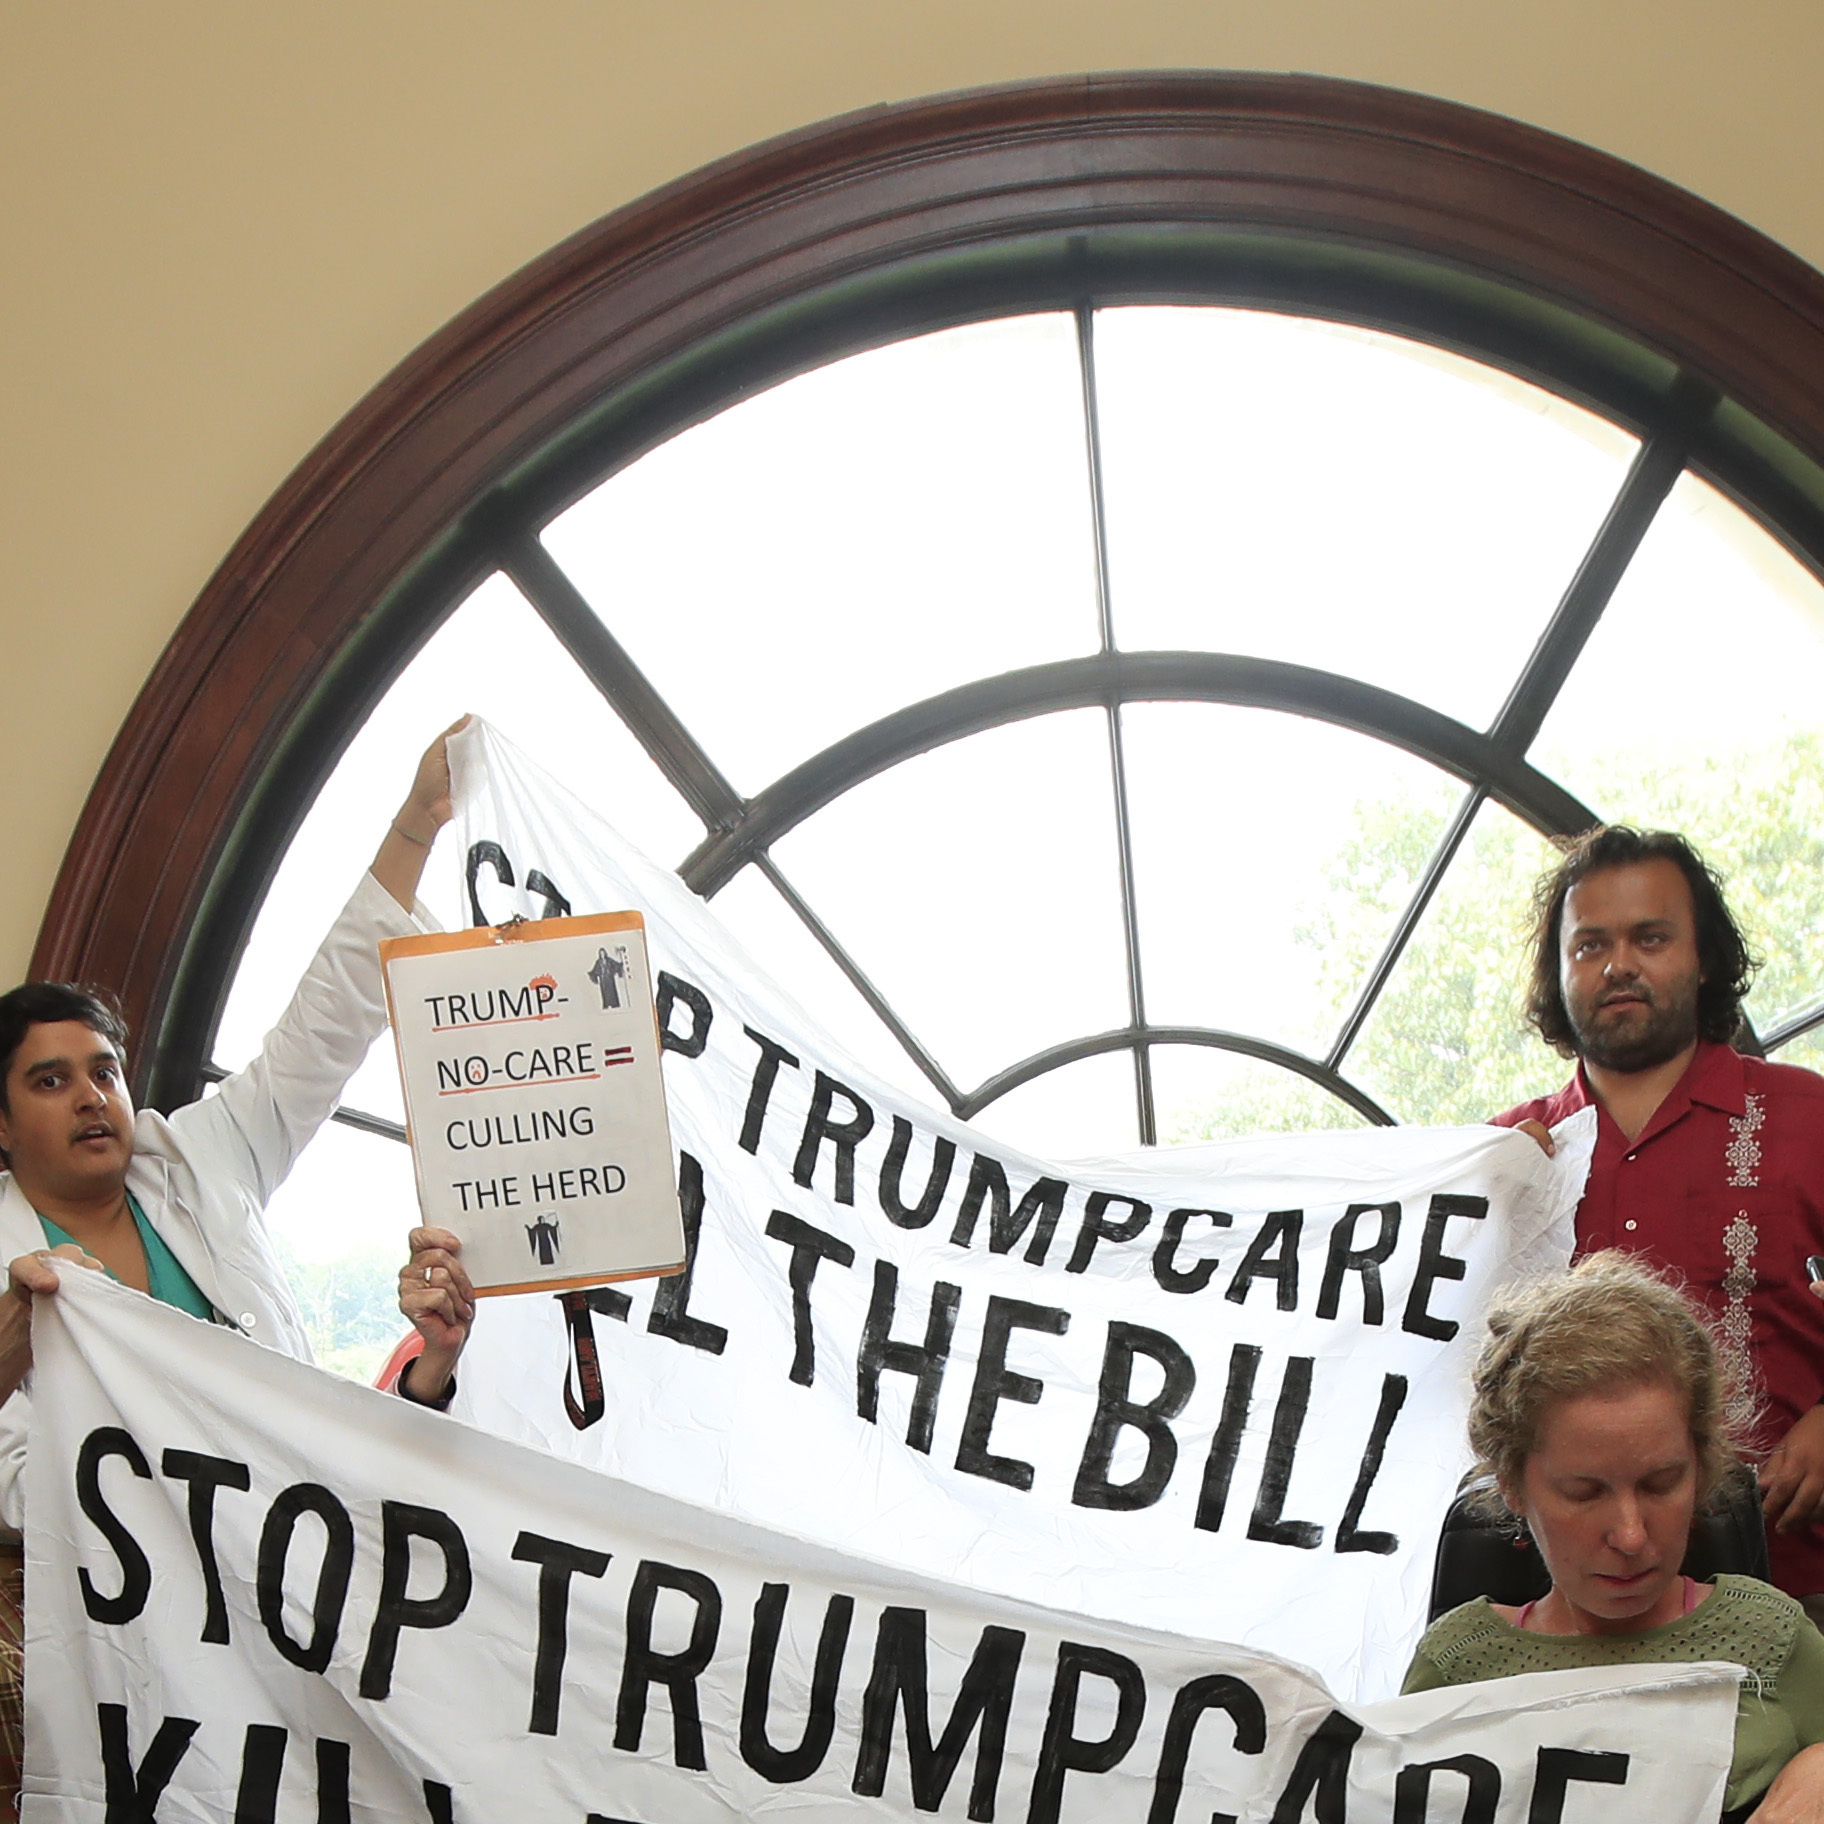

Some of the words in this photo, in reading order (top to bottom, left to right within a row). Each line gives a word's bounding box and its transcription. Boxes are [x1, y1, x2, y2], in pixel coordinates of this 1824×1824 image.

[423, 984, 570, 1027] TRUMP-
[436, 1042, 597, 1090] NO-CARE
[445, 1105, 595, 1151] CULLING
[452, 1176, 522, 1212] THE
[531, 1164, 627, 1204] HERD
[737, 1023, 1491, 1344] TRUMPCARE
[75, 1425, 474, 1703] STOP
